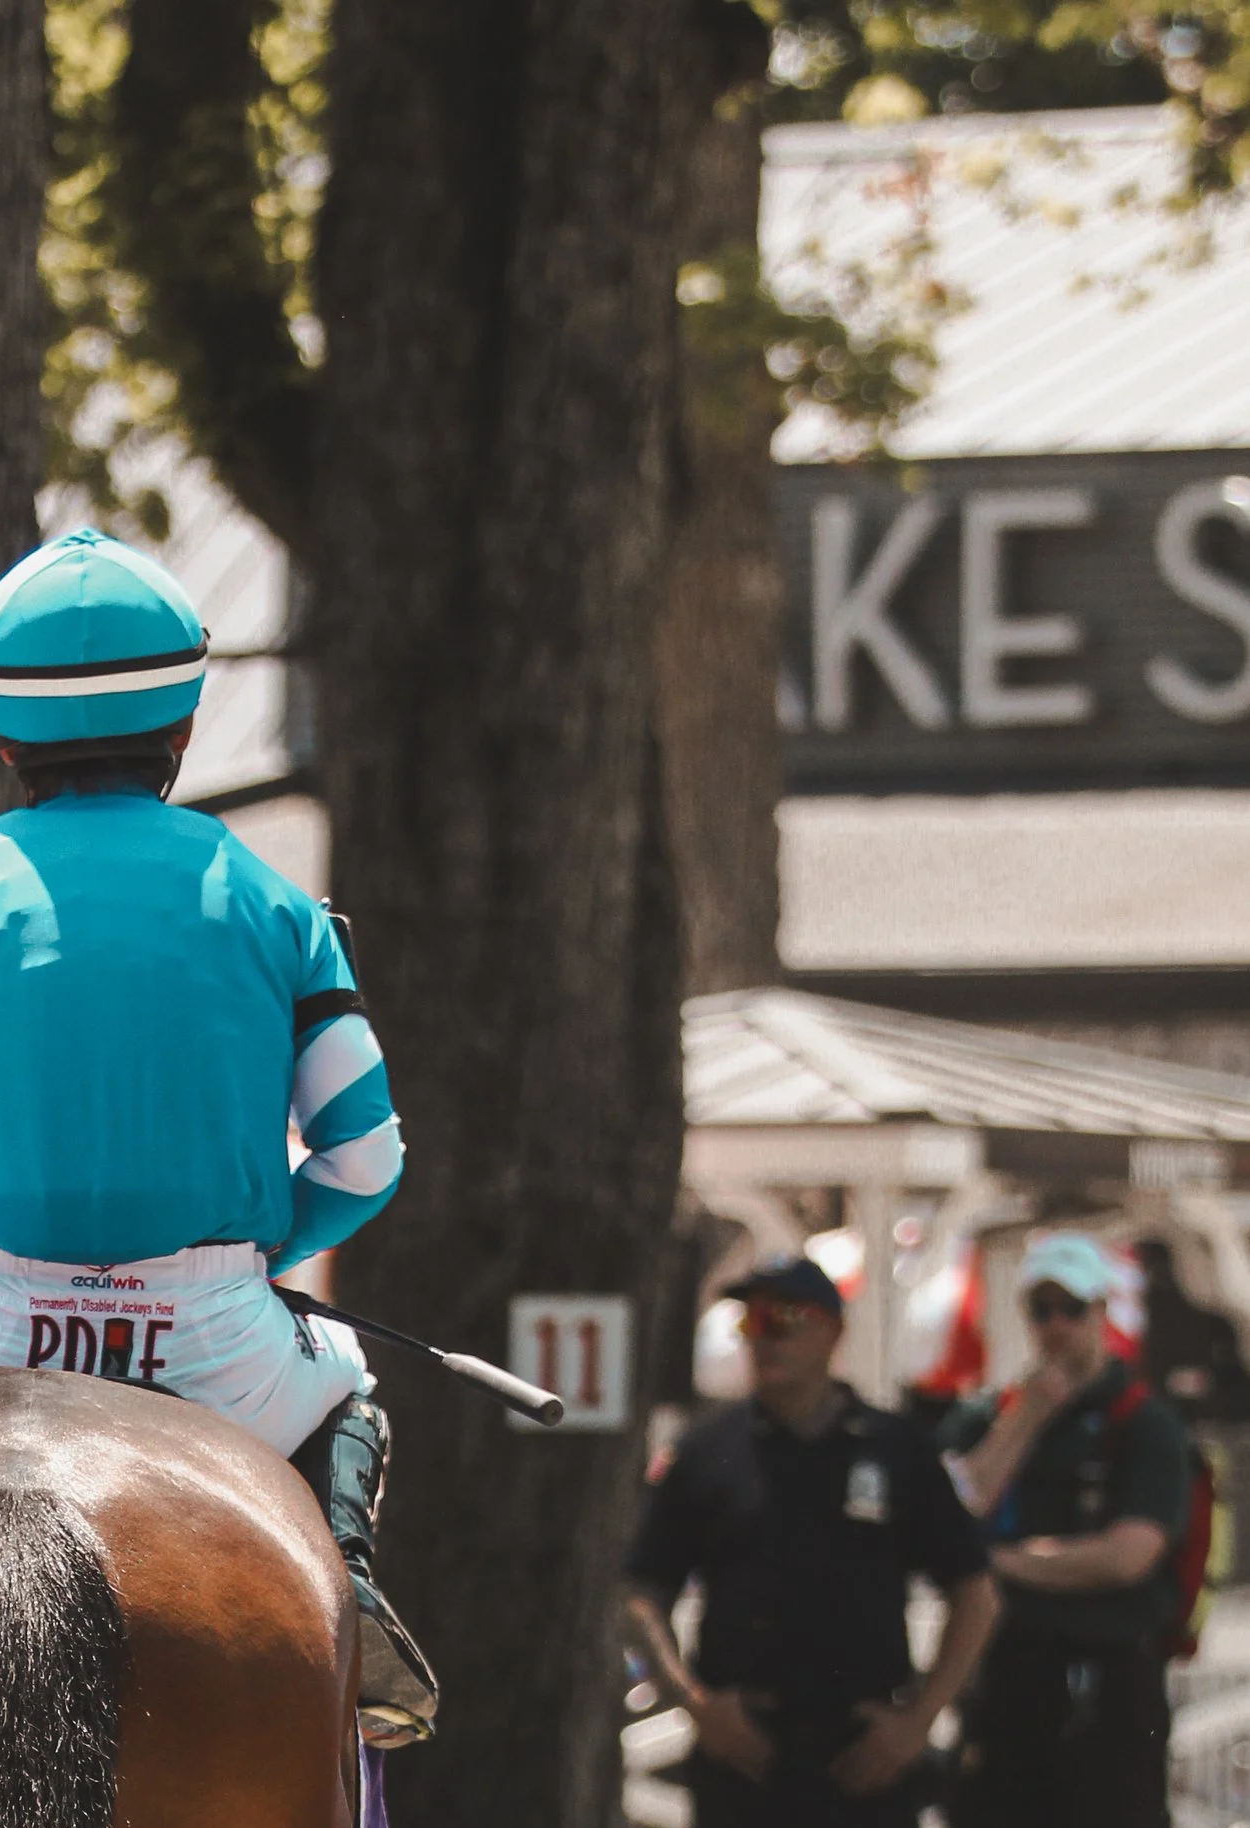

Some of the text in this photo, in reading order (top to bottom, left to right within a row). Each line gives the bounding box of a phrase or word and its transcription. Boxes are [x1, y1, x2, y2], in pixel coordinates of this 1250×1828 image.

[774, 488, 1096, 732] KE
[29, 1297, 175, 1318] Permanently Disabled Jockeys Fund
[71, 1274, 145, 1291] equiwin
[533, 1315, 602, 1408] 11
